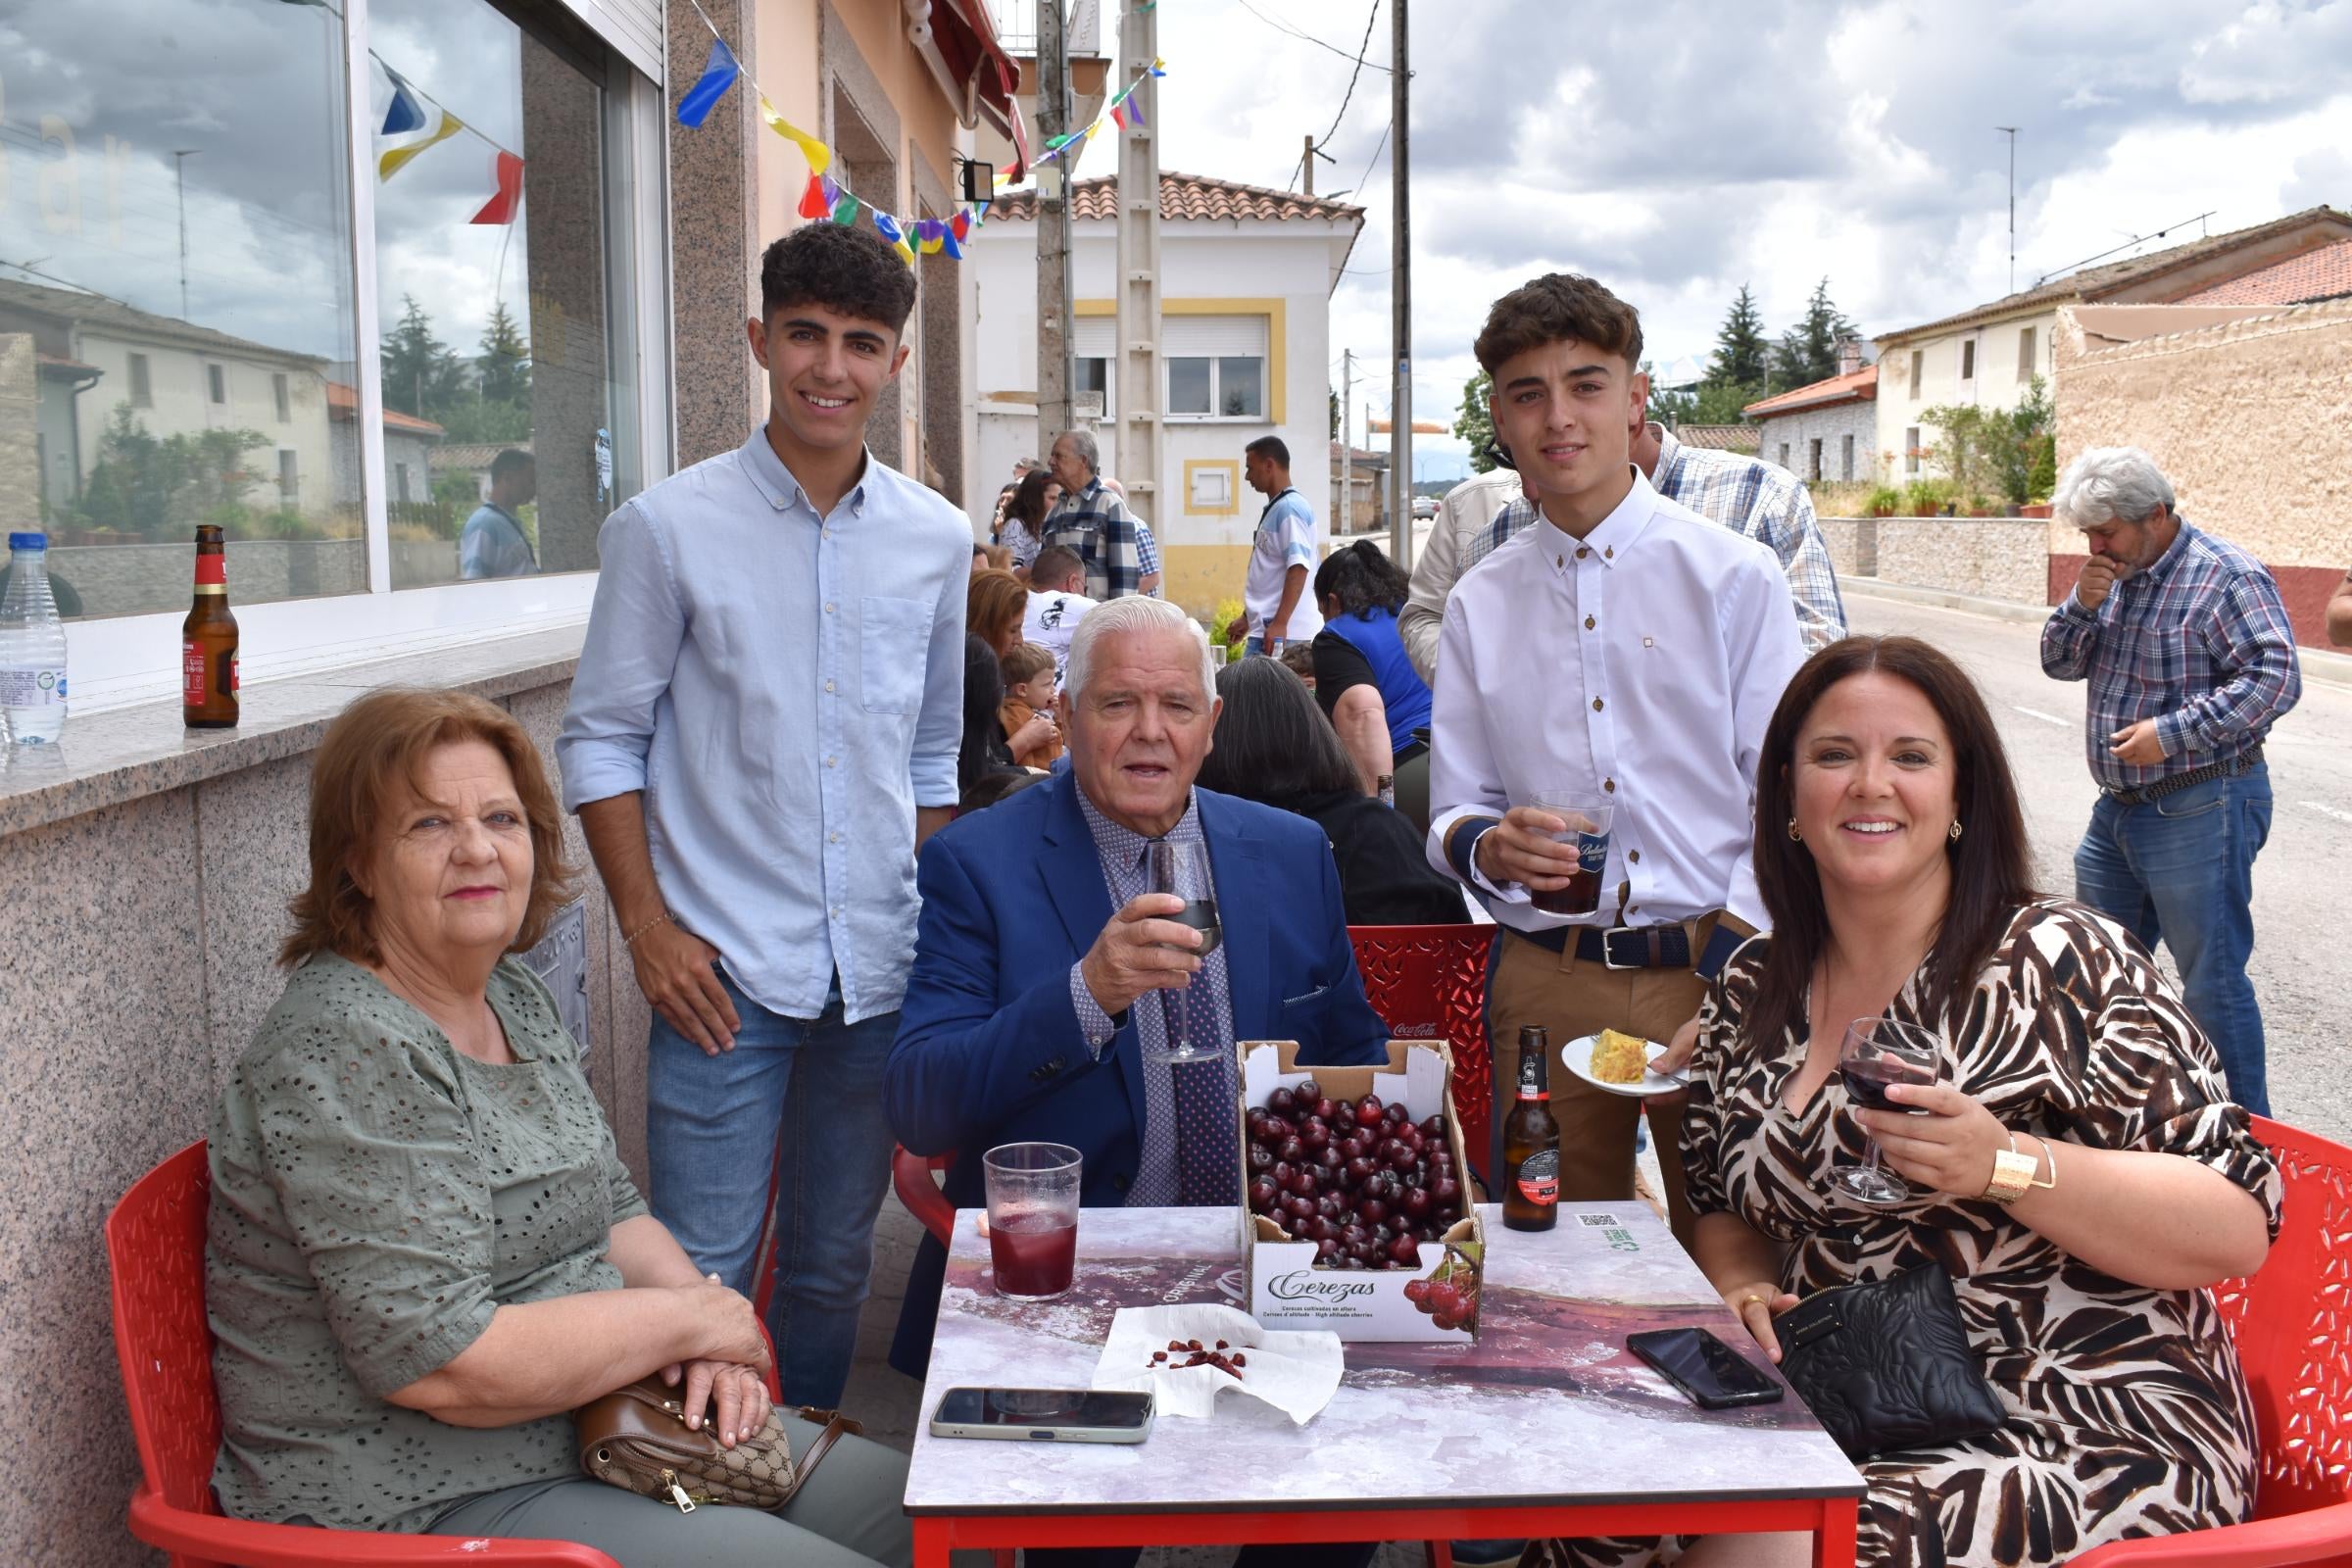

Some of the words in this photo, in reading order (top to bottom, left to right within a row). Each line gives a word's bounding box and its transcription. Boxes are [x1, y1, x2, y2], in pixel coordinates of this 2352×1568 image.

[0, 71, 133, 247] ar
[1394, 1022, 1437, 1037] Coca-Cola
[1162, 1264, 1212, 1302] ORIGINAL
[1268, 1270, 1375, 1302] Cerezas
